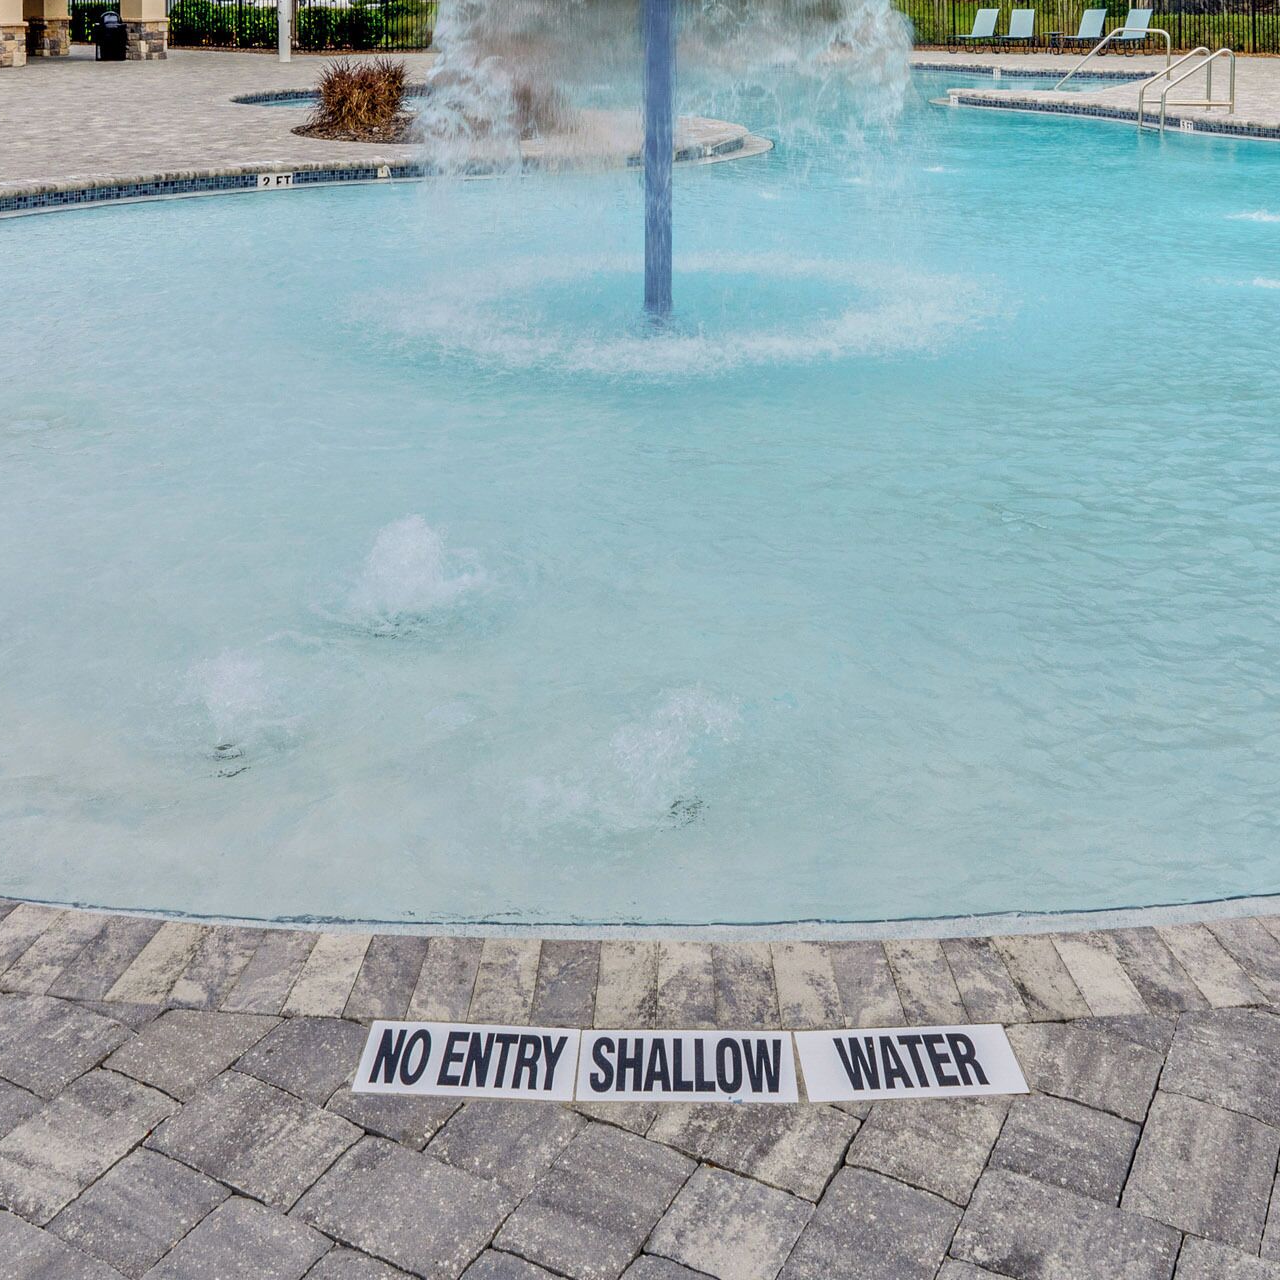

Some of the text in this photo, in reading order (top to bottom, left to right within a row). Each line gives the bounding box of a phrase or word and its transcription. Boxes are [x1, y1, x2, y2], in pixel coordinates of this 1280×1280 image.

[276, 175, 291, 185] FT
[368, 1028, 990, 1095] NO ENTRY SHALLOW WATER
